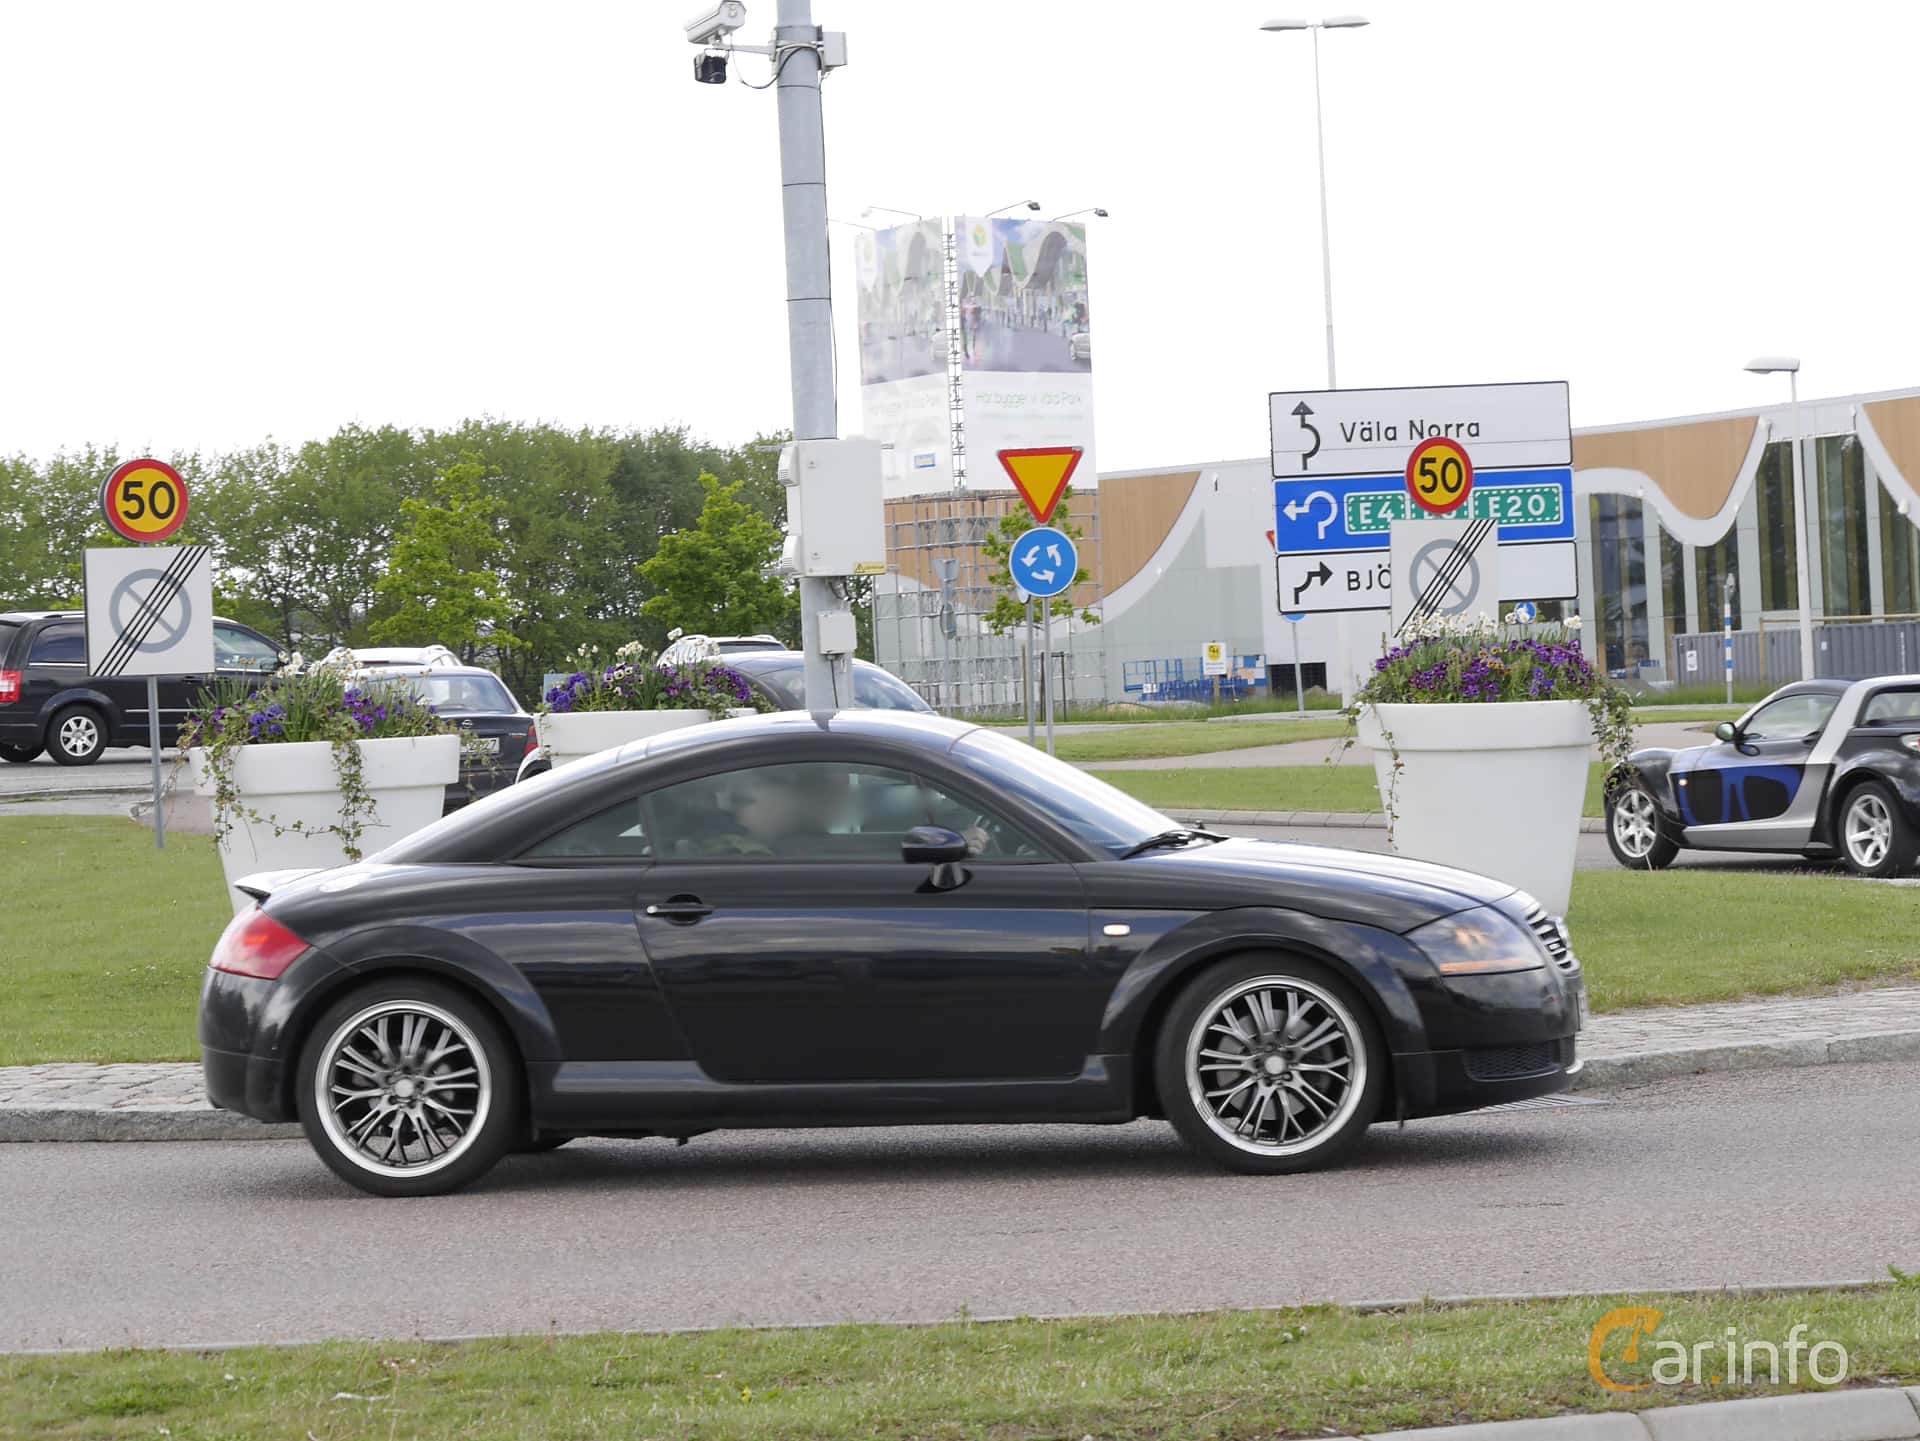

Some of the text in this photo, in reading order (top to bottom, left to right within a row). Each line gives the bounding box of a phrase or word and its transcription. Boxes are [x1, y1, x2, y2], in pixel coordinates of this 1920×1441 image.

[1340, 419, 1480, 443] Väla Norra
[1420, 457, 1463, 493] 50
[123, 480, 175, 520] 50
[1488, 494, 1545, 518] E20
[1360, 501, 1395, 524] E4
